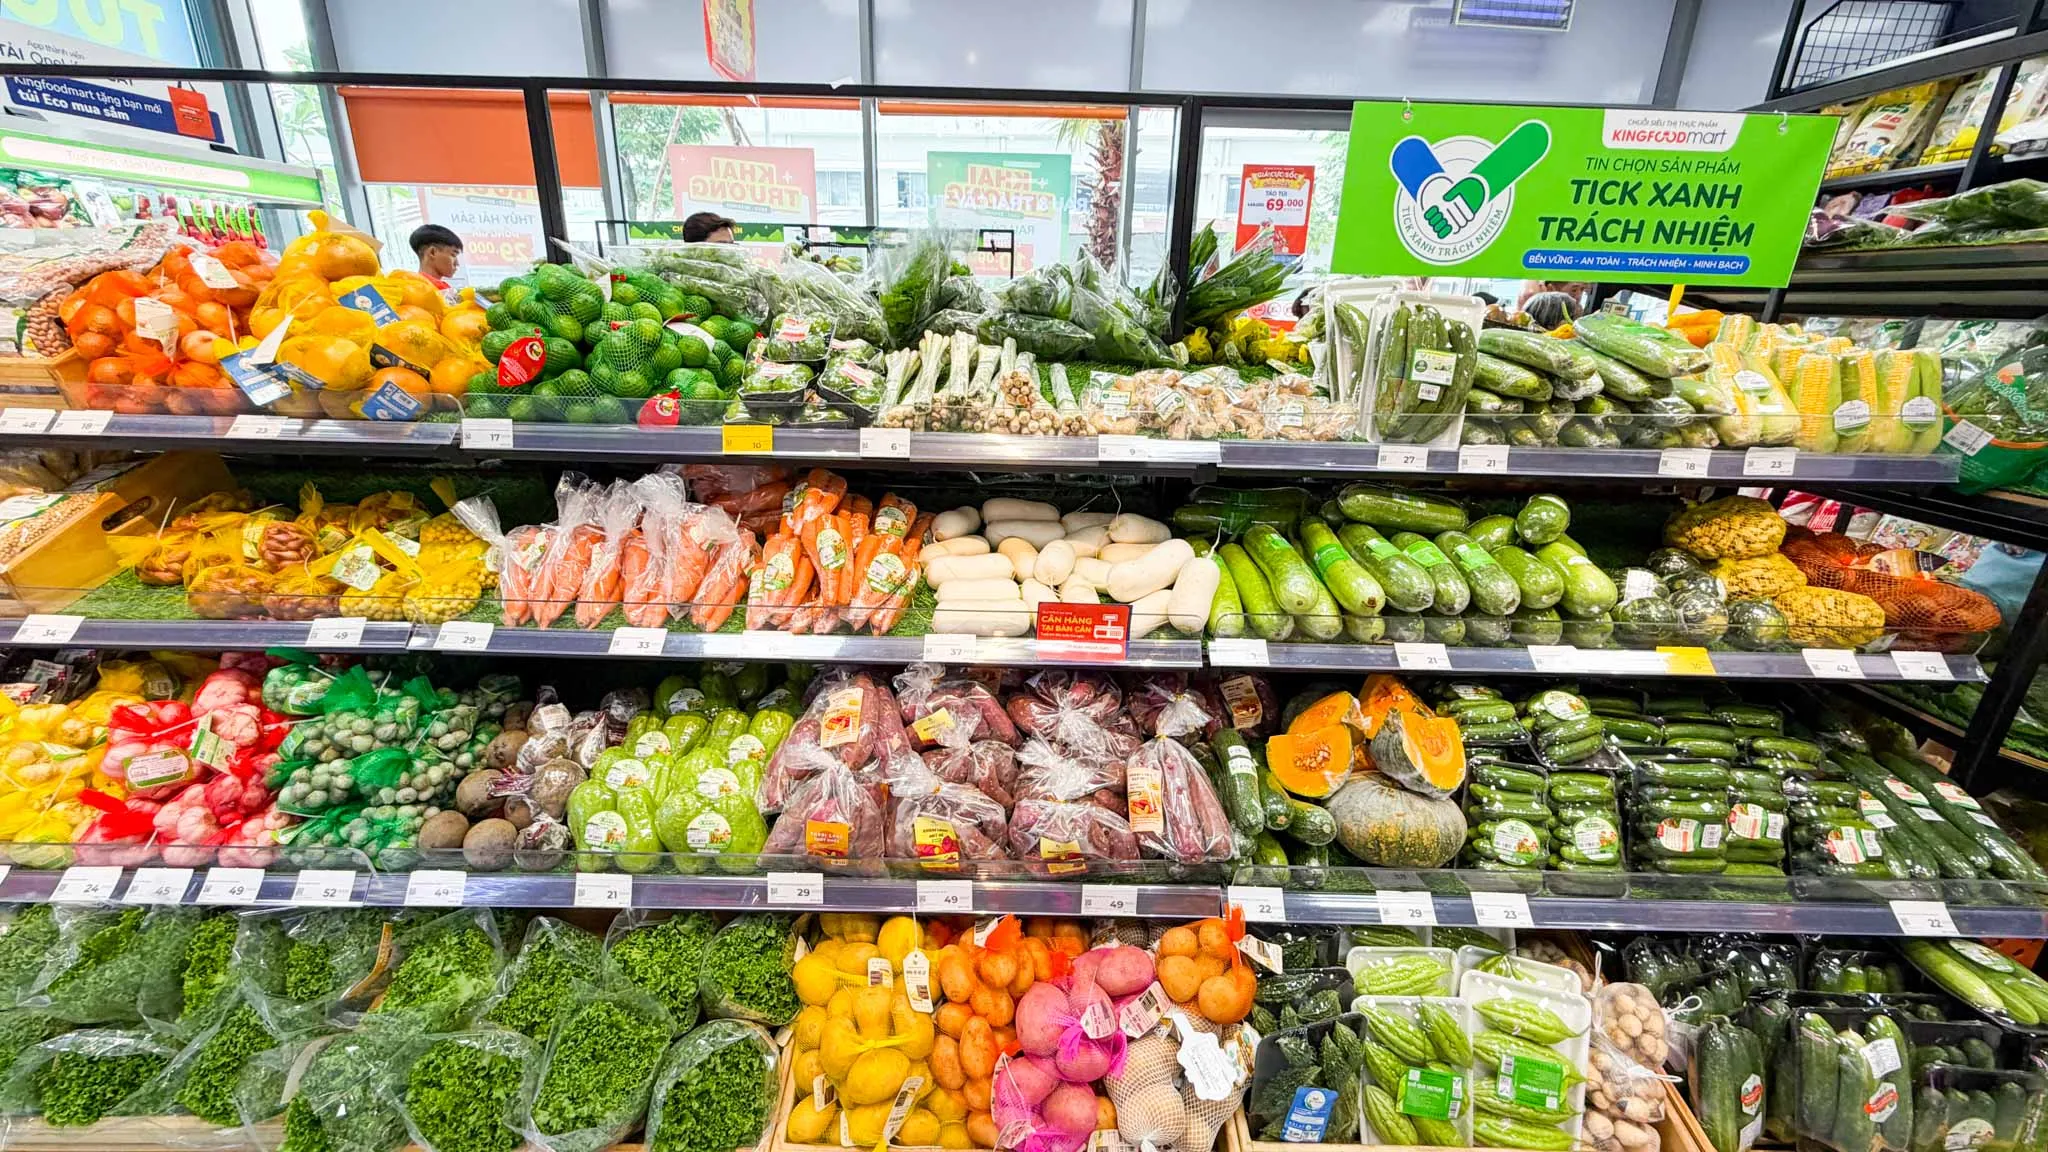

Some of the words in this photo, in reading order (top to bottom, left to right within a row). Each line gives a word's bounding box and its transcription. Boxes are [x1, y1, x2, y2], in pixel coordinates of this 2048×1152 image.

[17, 88, 39, 104] túi
[42, 93, 68, 109] Eco
[72, 101, 101, 115] mua
[103, 105, 130, 121] sắm
[96, 91, 122, 108] tặng
[123, 96, 143, 112] bạn
[1612, 128, 1728, 145] KINGFOODmart
[1585, 156, 1609, 171] TIN
[1612, 158, 1657, 176] CHỌN
[1659, 156, 1693, 174] SẢN
[1694, 156, 1741, 175] PHẨM
[1571, 179, 1643, 206] TICK
[1647, 181, 1743, 209] XANH
[1266, 198, 1304, 211] 69.000
[1402, 207, 1413, 233] TICK
[1409, 232, 1435, 255] XANH
[1537, 210, 1645, 244] TRÁCH
[1652, 215, 1755, 253] NHIỆM
[1529, 252, 1546, 264] BỀN
[1548, 253, 1574, 265] VỮNG
[1580, 256, 1595, 265] AN
[1596, 255, 1621, 266] TOÀN
[1627, 256, 1657, 268] TRÁCH
[1658, 258, 1687, 269] NHIỆM
[1693, 260, 1724, 269] MINH
[1724, 261, 1744, 270] BẠCH
[490, 433, 501, 442] 17
[1403, 456, 1415, 464] 27
[1487, 459, 1496, 468] 21
[1686, 462, 1696, 470] 18
[1770, 461, 1782, 469] 23
[333, 631, 348, 640] 49
[462, 636, 476, 645] 29
[637, 640, 650, 649] 33
[83, 884, 99, 893] 24
[155, 886, 170, 895] 45
[228, 886, 244, 895] 49
[322, 888, 337, 898] 52
[797, 888, 810, 897] 29
[607, 891, 617, 900] 21
[943, 895, 958, 904] 49
[1109, 900, 1123, 909] 49
[1259, 905, 1272, 914] 22
[1409, 909, 1422, 918] 29
[1503, 911, 1517, 920] 23
[1927, 918, 1941, 927] 22
